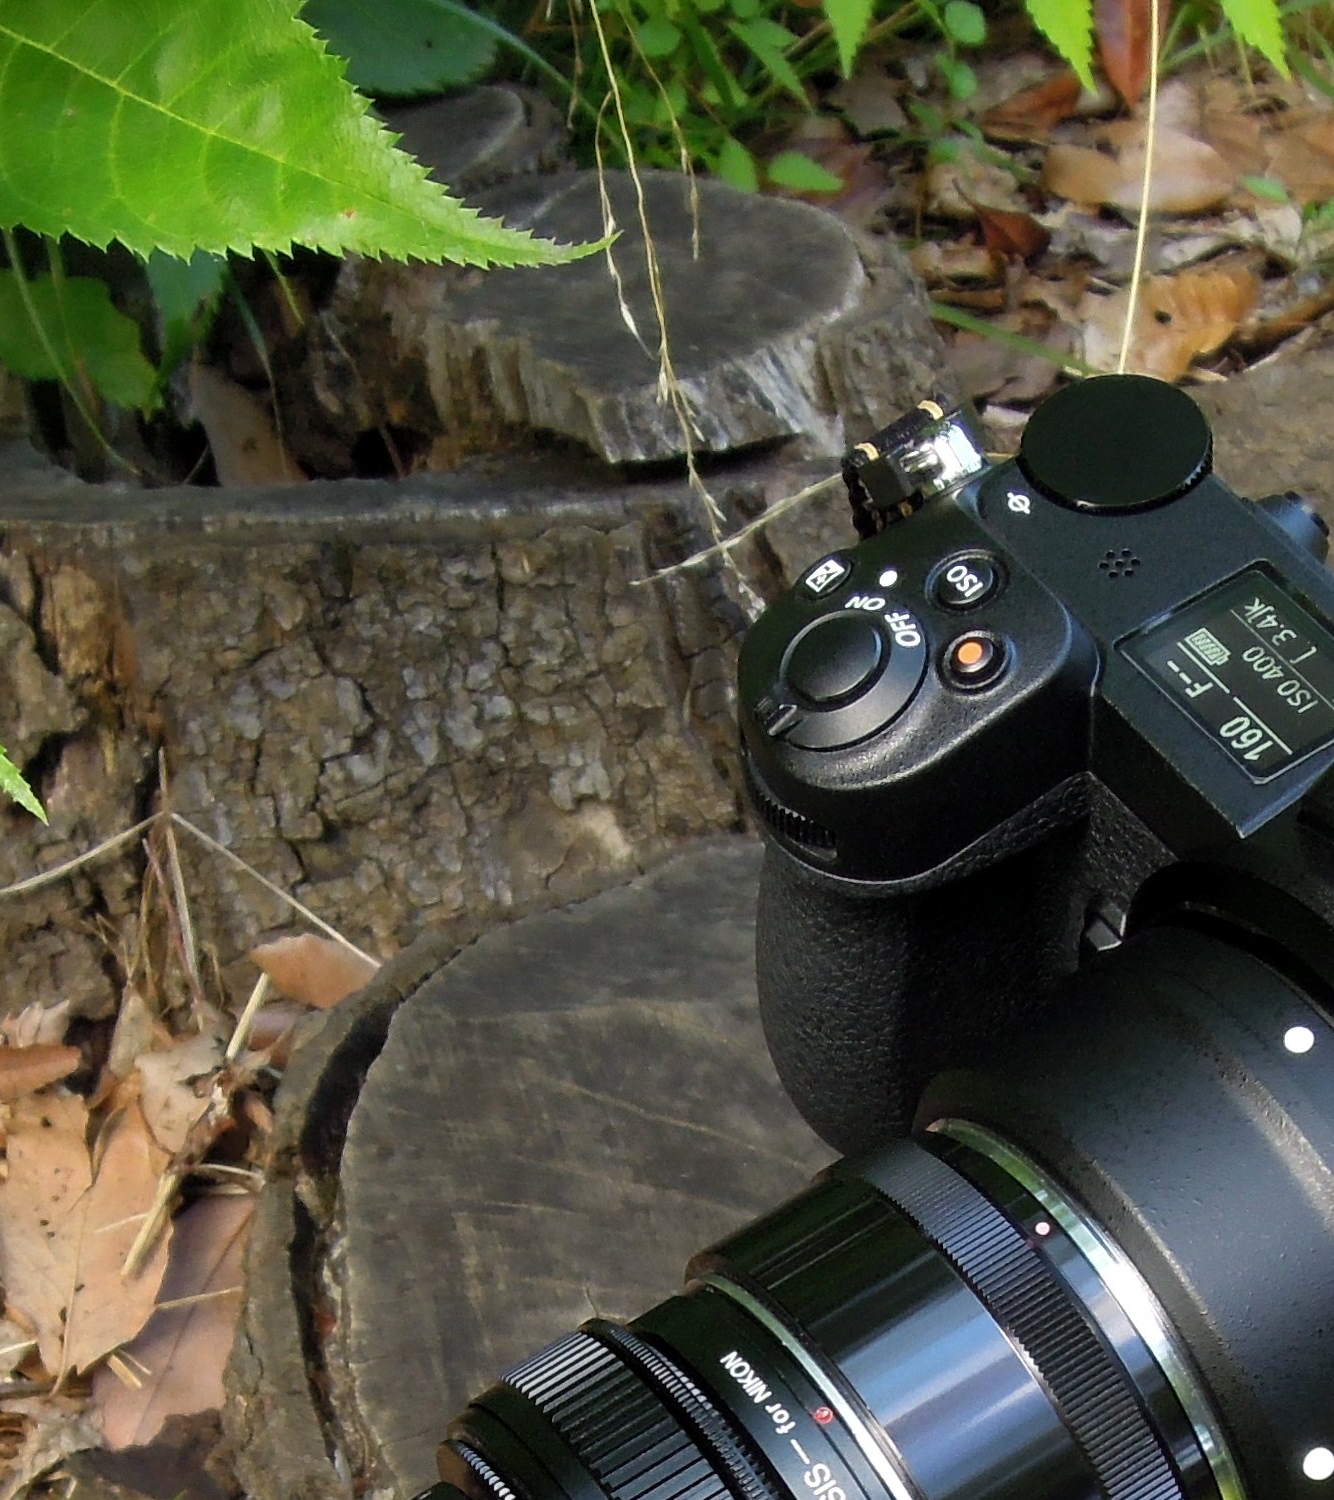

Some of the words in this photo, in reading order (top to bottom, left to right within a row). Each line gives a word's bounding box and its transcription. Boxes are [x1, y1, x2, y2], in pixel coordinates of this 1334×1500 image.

[947, 565, 983, 597] ISO
[845, 596, 886, 611] ON
[884, 612, 921, 647] OFF
[1242, 646, 1284, 680] 400
[1277, 679, 1318, 713] ISO
[1220, 716, 1274, 760] 160
[720, 1351, 772, 1404] NIKON
[765, 1403, 796, 1434] for
